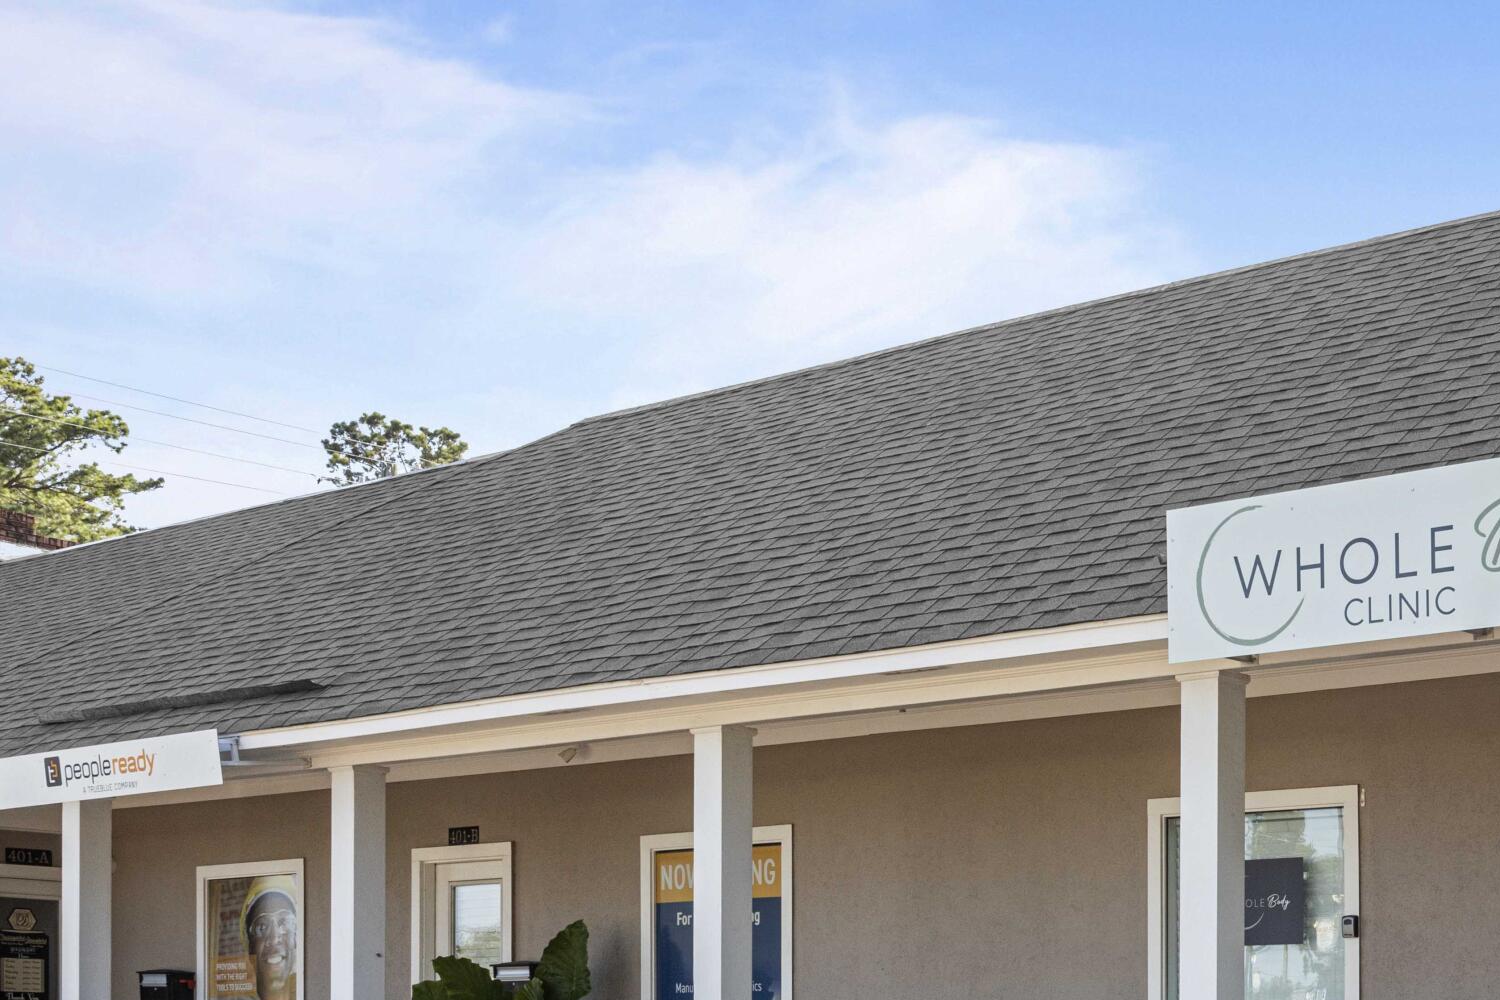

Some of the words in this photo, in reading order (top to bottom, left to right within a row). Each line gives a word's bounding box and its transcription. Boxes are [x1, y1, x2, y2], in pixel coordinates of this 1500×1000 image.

[1233, 525, 1455, 599] WHOLE
[1344, 586, 1456, 626] CLINIC
[64, 749, 155, 787] peopleready
[114, 781, 138, 791] COMPANY
[450, 829, 479, 843] 401-B
[7, 850, 49, 864] 401-A
[1246, 898, 1265, 908] OLE
[1267, 893, 1291, 911] Body
[676, 912, 692, 926] For
